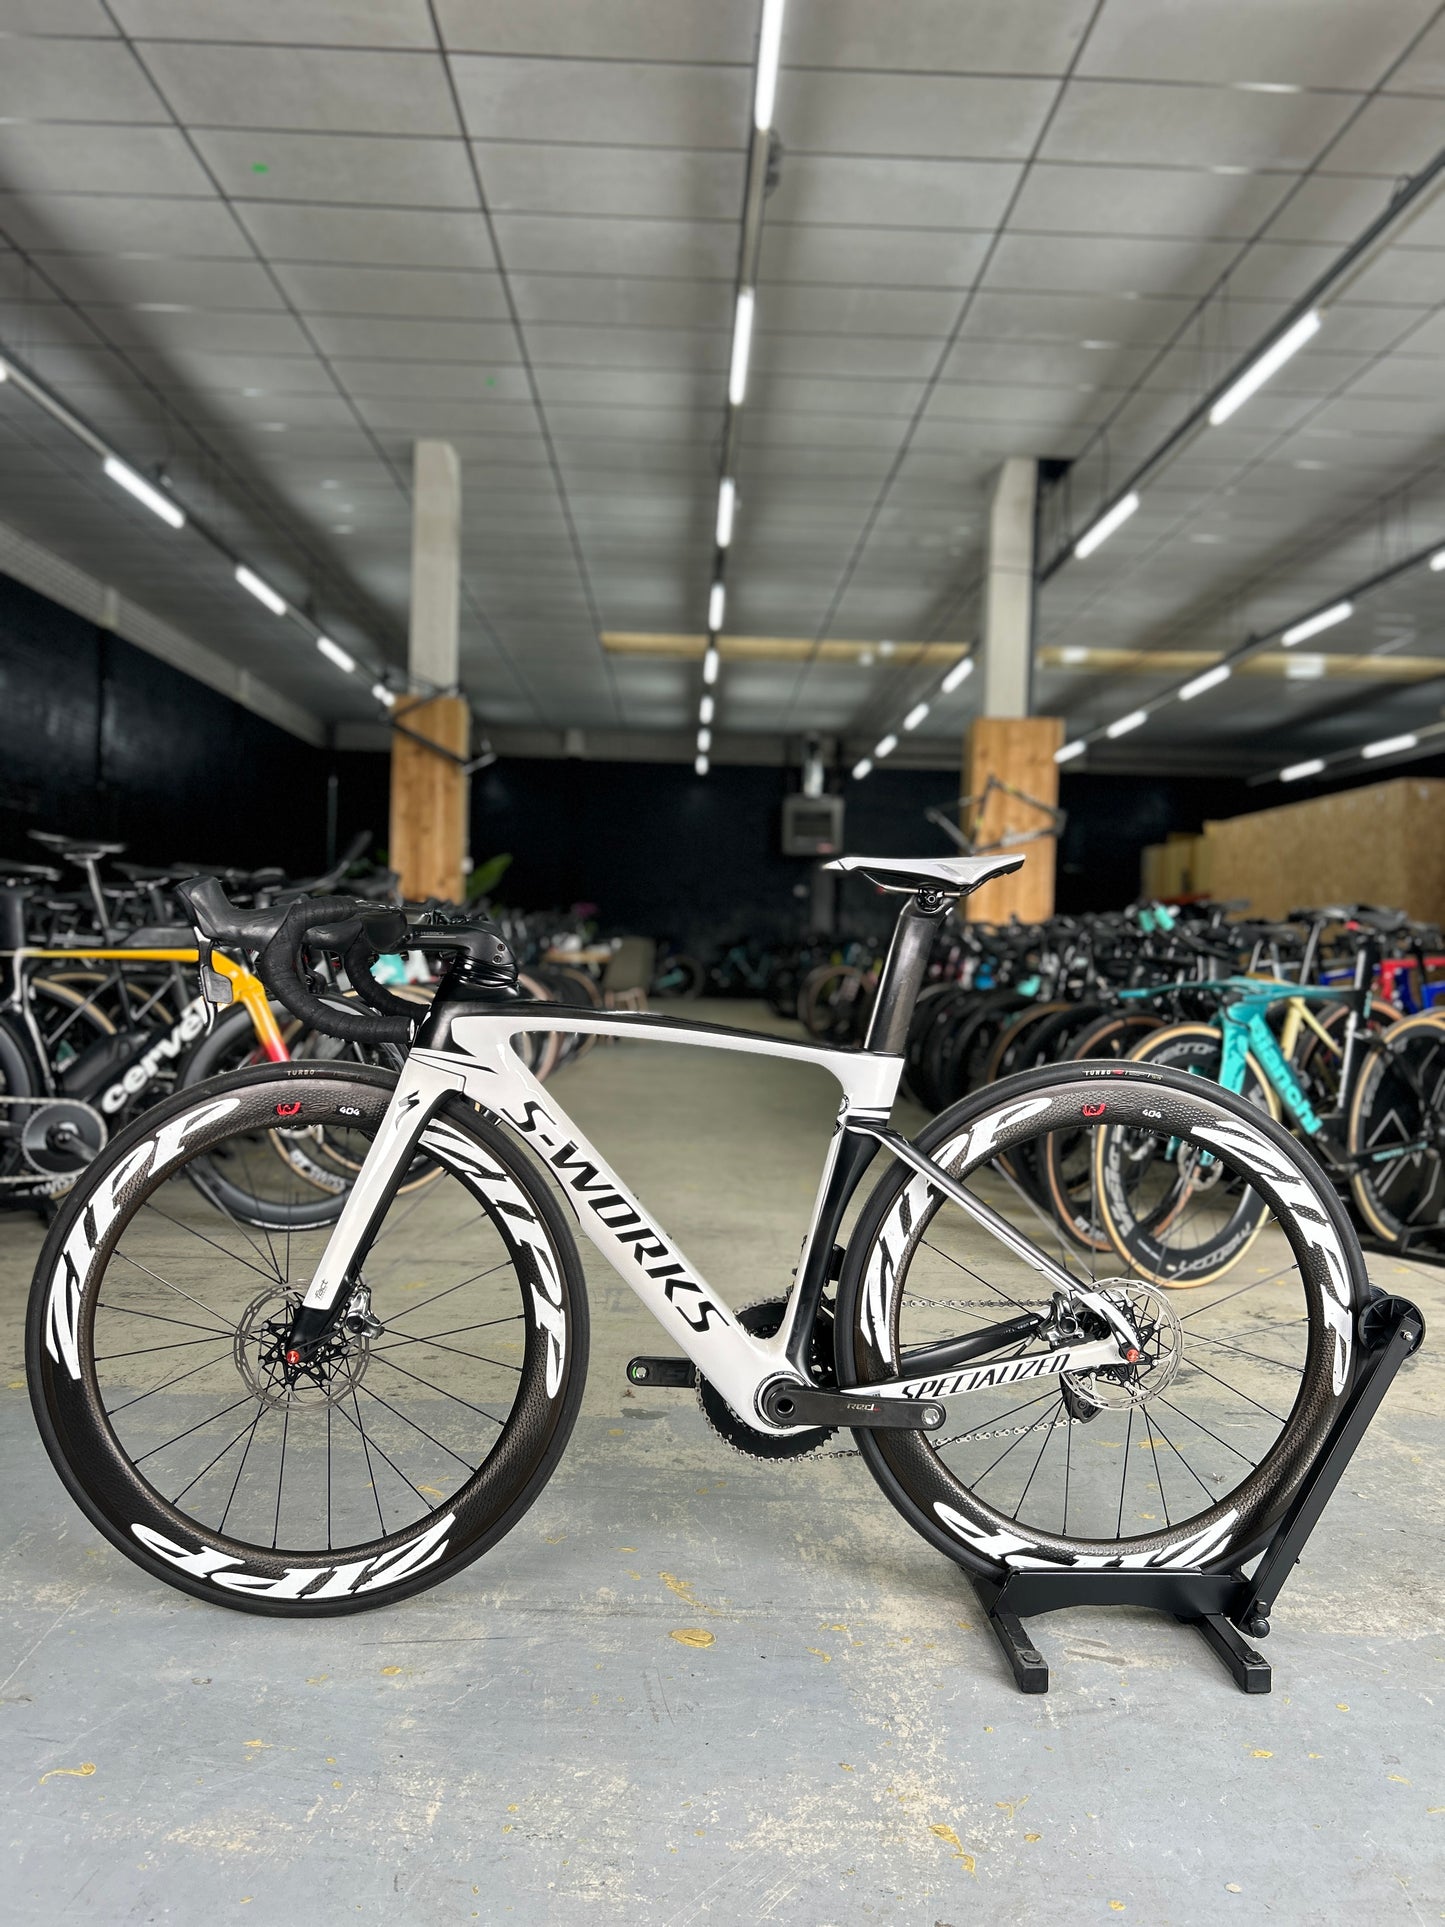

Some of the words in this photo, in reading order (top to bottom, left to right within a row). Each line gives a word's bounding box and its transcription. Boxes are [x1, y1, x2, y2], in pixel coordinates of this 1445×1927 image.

[339, 1106, 361, 1117] 404
[1084, 1069, 1112, 1077] TURBO
[1142, 1108, 1162, 1120] 404
[1249, 1014, 1323, 1134] Bianchi
[46, 1098, 240, 1379] ZIPP
[417, 1118, 566, 1399] ZIPP
[501, 1100, 730, 1333] S-WORKS
[860, 1098, 1053, 1363] ZIPP
[1190, 1121, 1353, 1397] ZIPP
[902, 1353, 1071, 1399] SPECIALIZED
[131, 1513, 456, 1599] ZIPP
